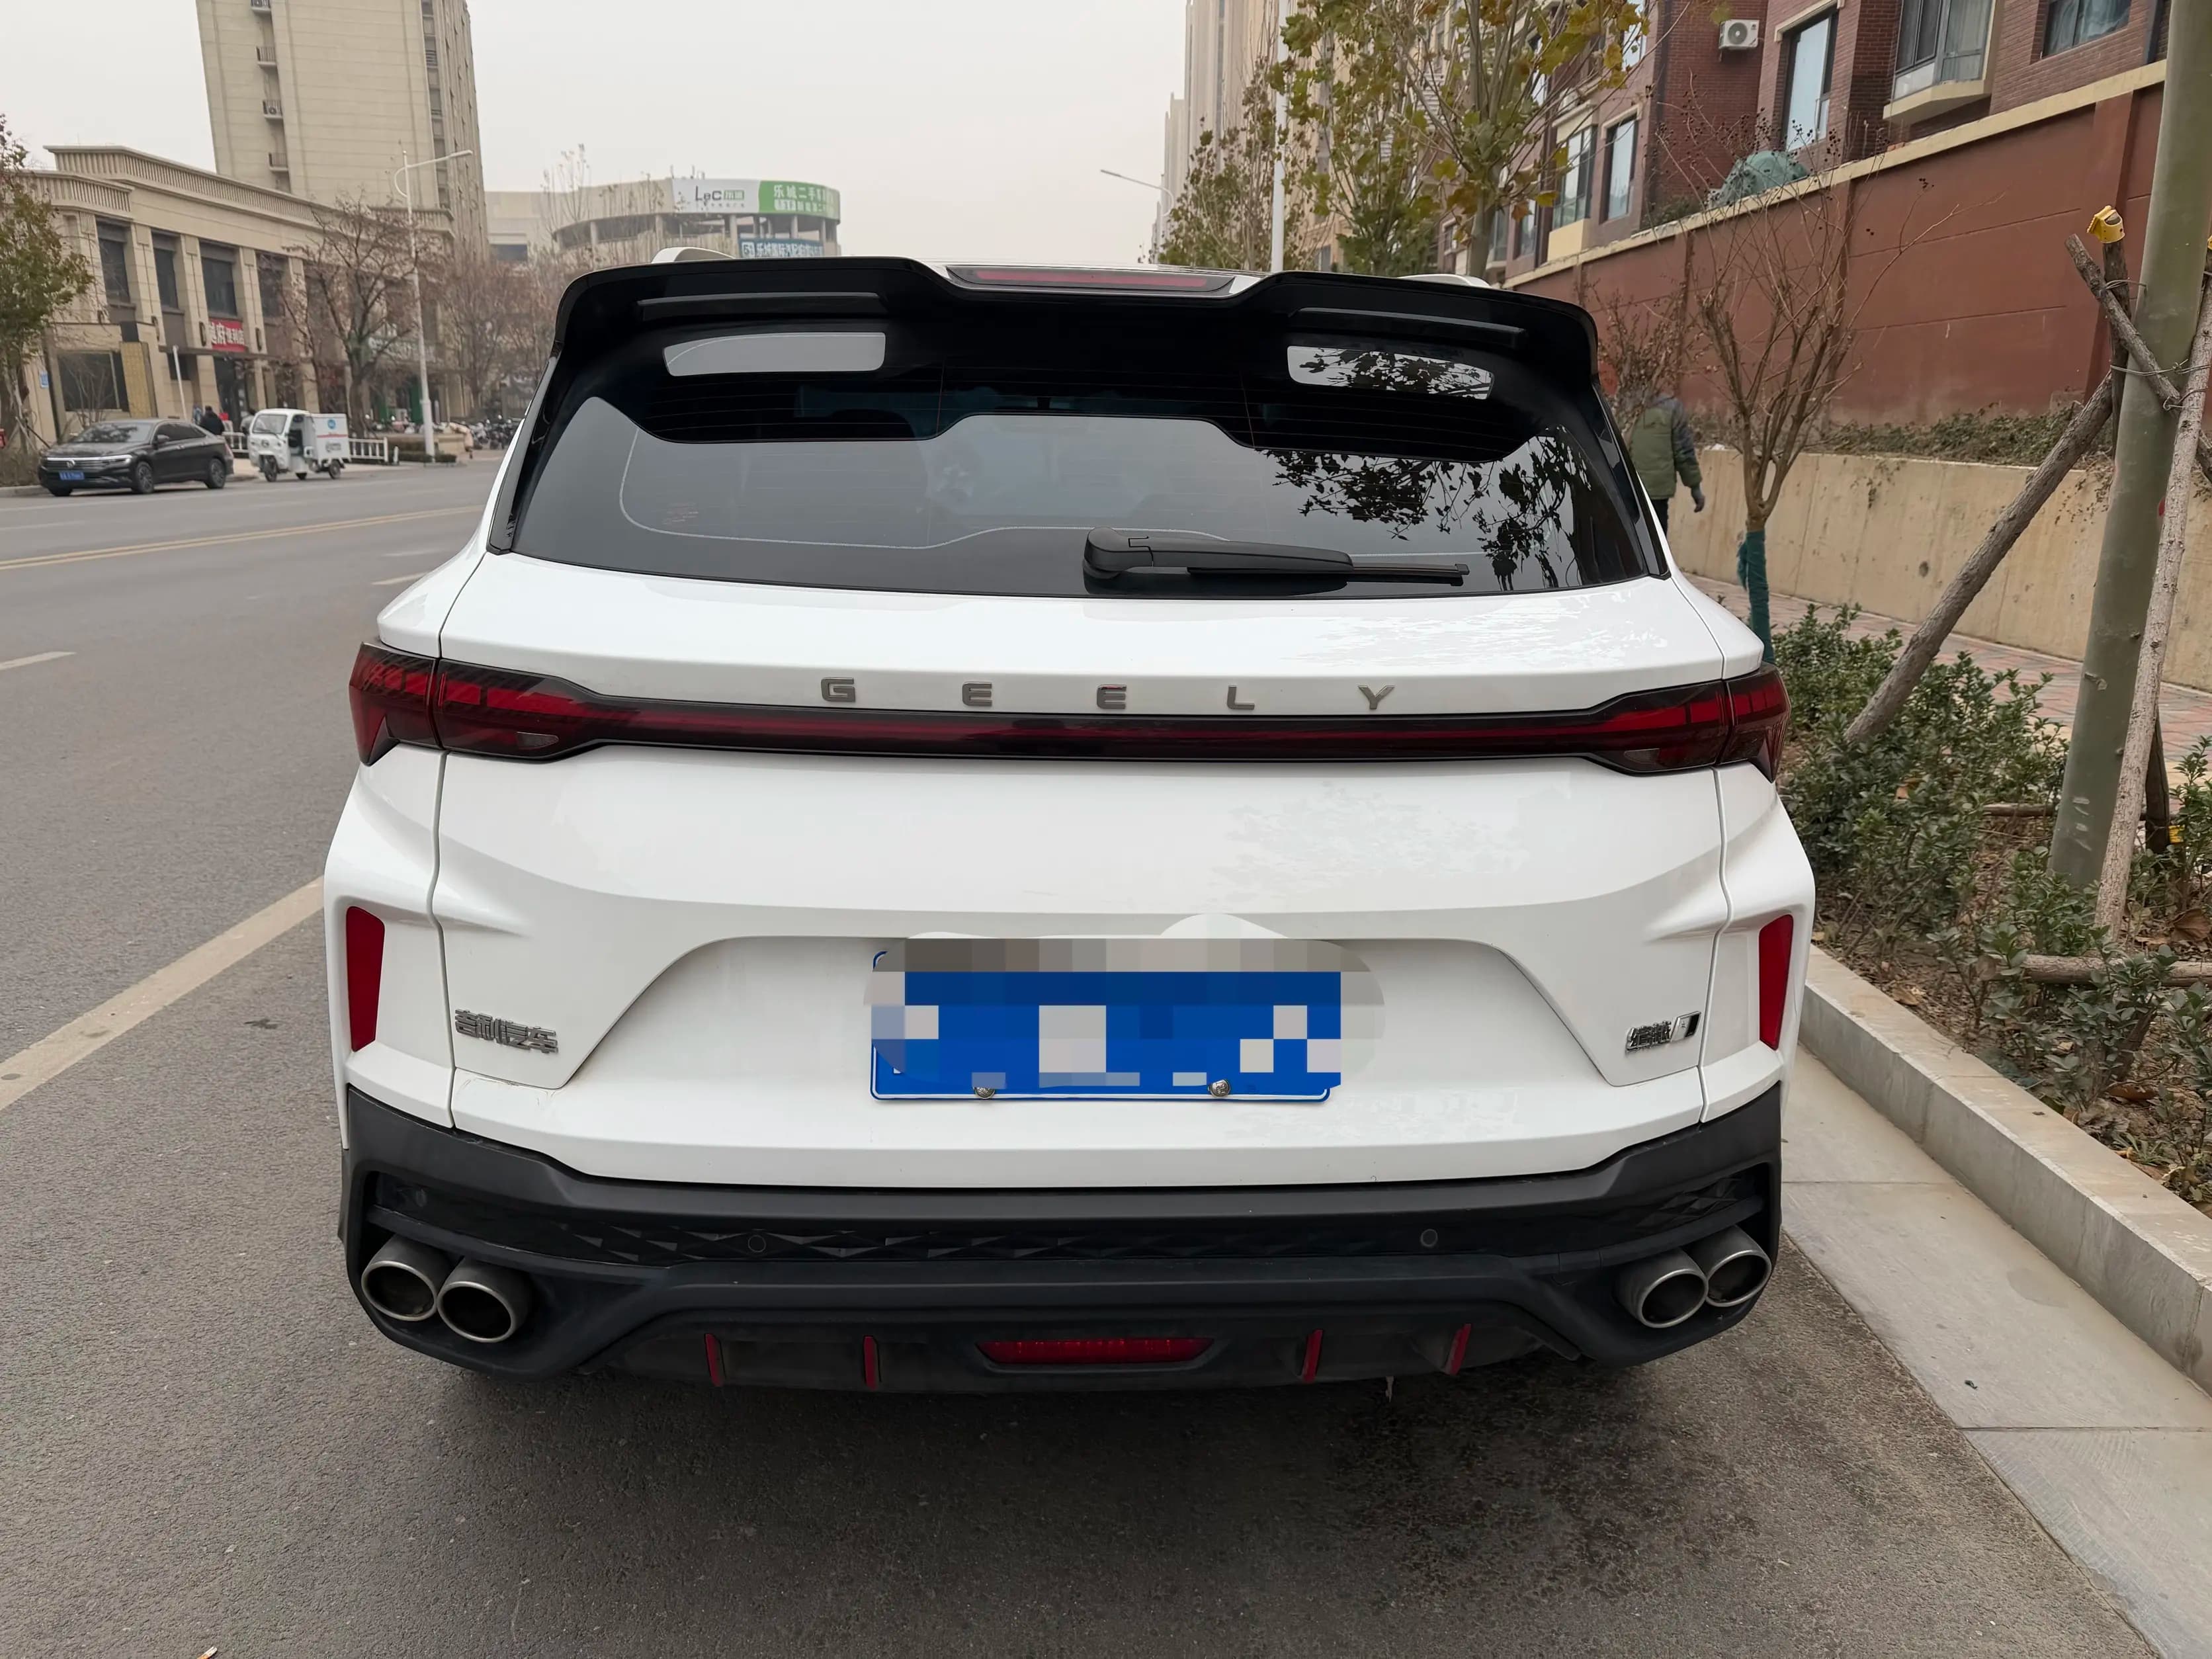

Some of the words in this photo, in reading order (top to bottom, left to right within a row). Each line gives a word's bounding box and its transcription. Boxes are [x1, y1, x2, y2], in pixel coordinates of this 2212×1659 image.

[821, 677, 1395, 710] GEELY
[455, 1009, 559, 1054] 吉利汽车
